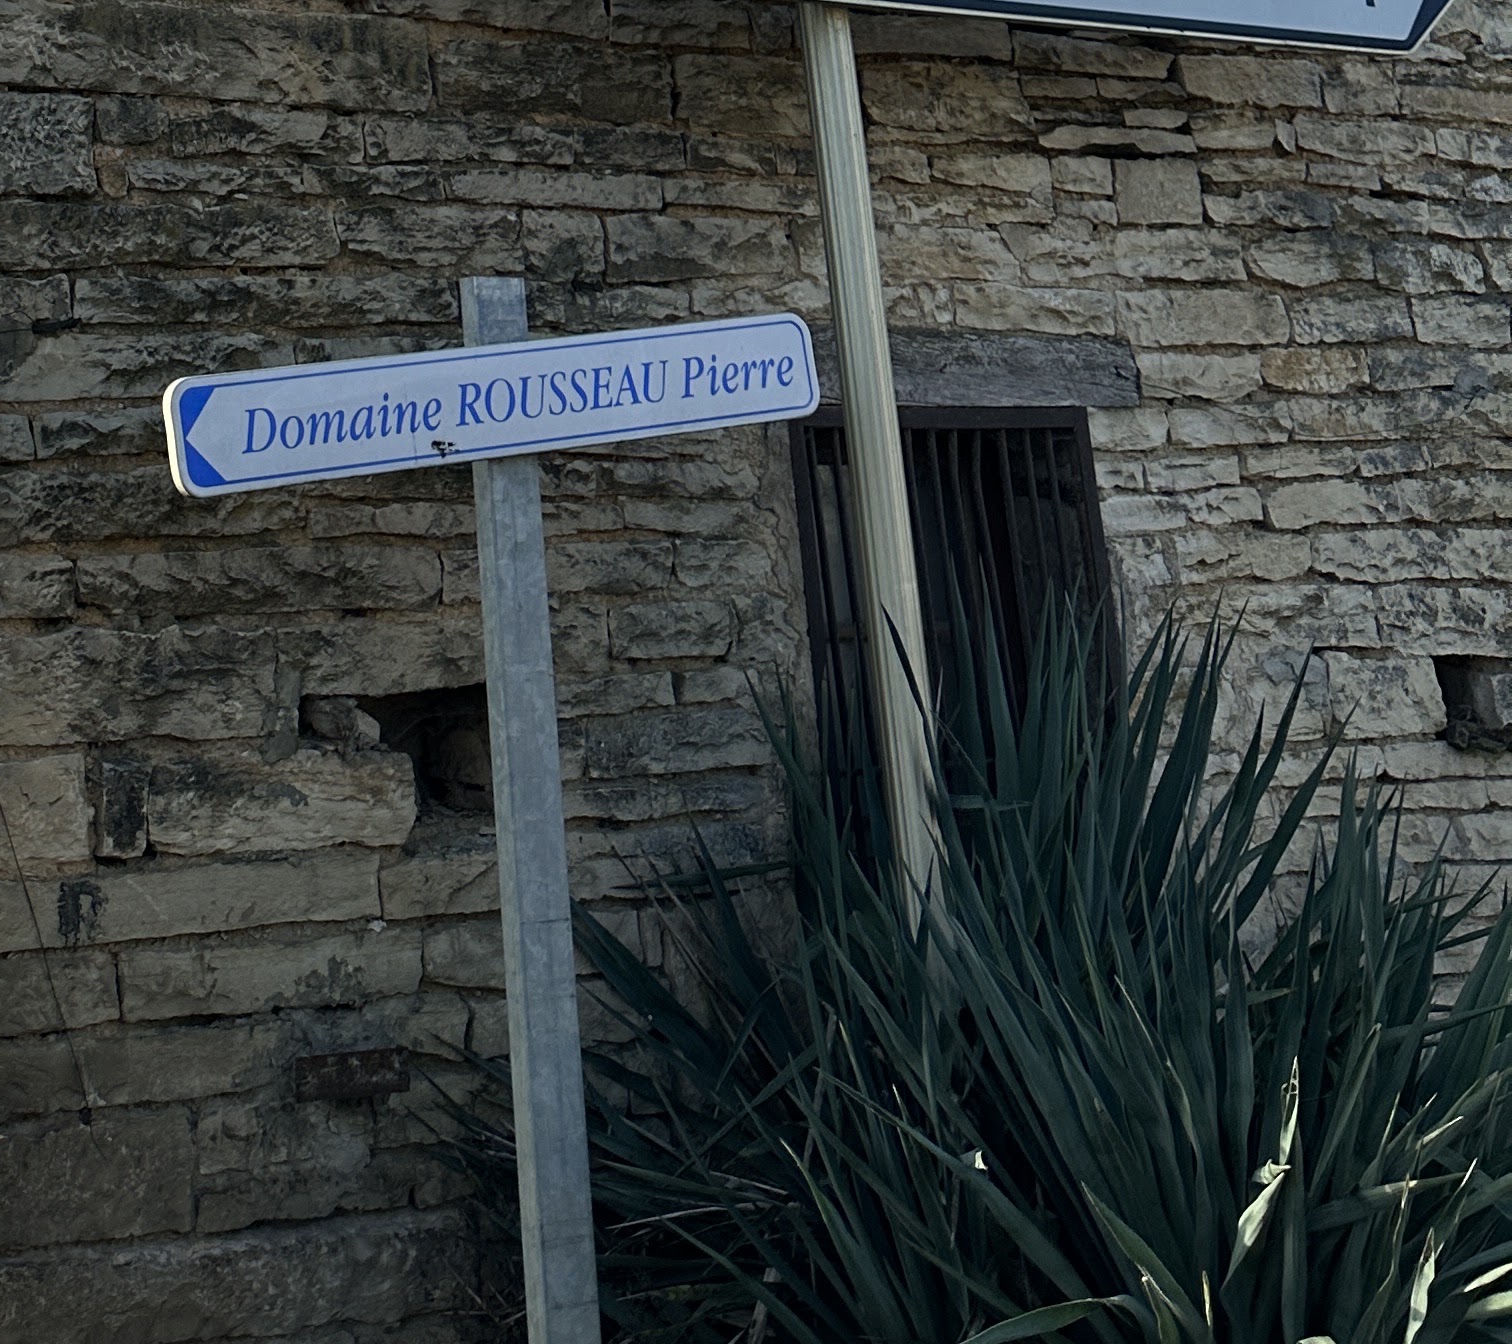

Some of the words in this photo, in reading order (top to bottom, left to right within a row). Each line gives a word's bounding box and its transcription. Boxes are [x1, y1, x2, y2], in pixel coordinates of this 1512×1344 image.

[241, 392, 442, 454] Domaine
[456, 359, 669, 427] ROUSSEAU
[682, 354, 795, 399] Pierre
